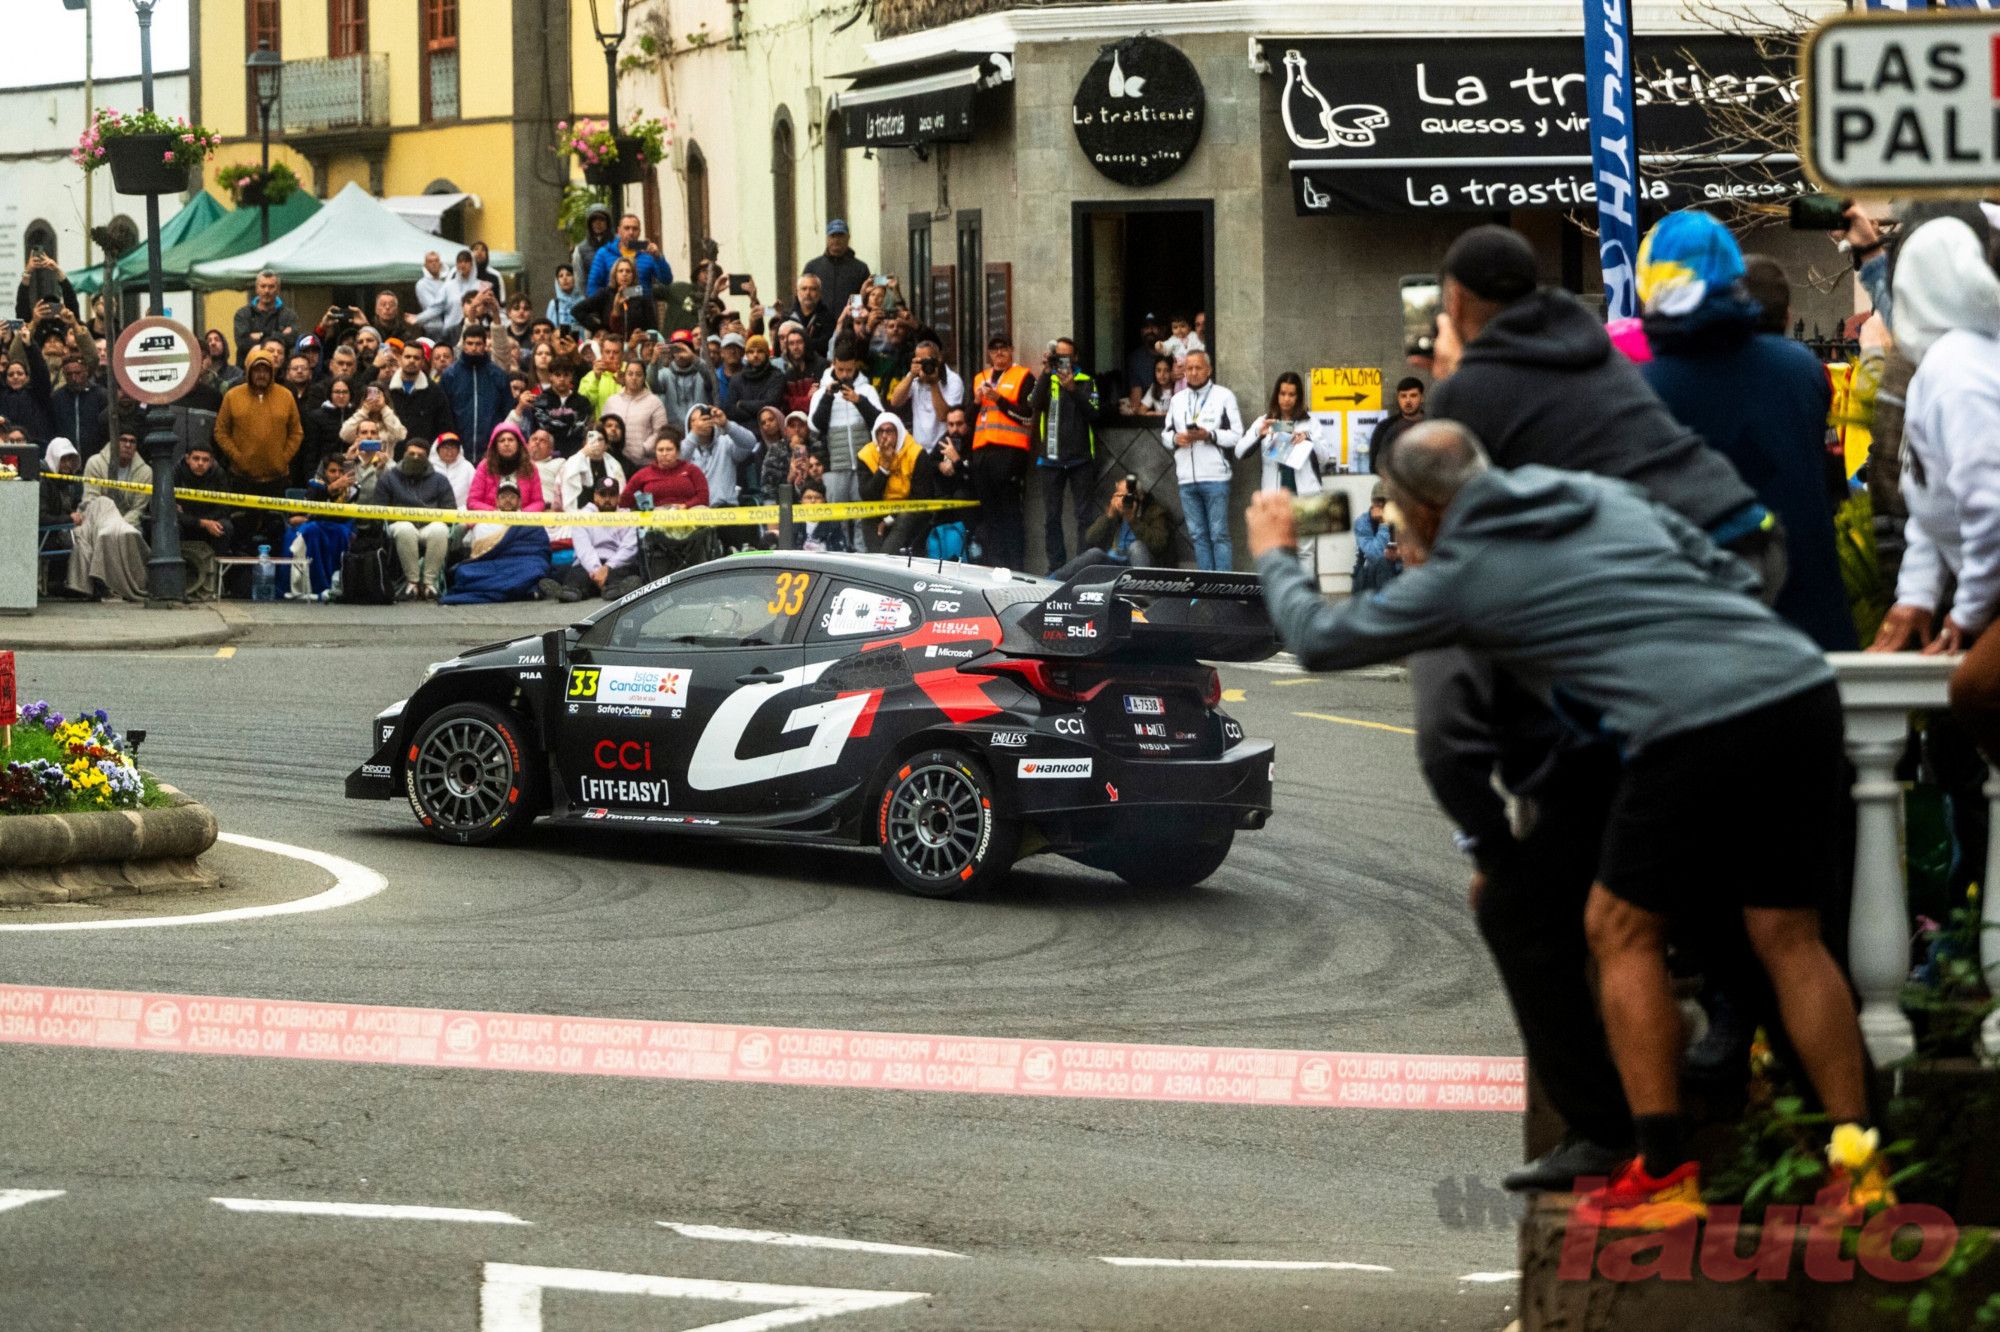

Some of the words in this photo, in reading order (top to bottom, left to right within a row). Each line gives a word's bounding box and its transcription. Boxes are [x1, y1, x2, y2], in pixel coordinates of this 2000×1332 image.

[1832, 41, 1967, 93] LAS
[1416, 63, 1488, 106] La
[1510, 64, 1804, 107] trstien
[1073, 105, 1093, 124] La
[1100, 105, 1195, 123] trastienda
[1535, 117, 1548, 137] y
[1556, 111, 1592, 132] vin
[1832, 106, 2000, 163] PAL
[1406, 177, 1450, 207] La
[1461, 175, 1670, 207] trastiea
[1333, 369, 1382, 386] PALOMO
[357, 504, 391, 515] ZONA
[393, 506, 443, 517] PUBLICO
[490, 512, 541, 522] PUBLICO
[652, 511, 690, 522] ZONA
[693, 511, 737, 522] PUBLICO
[748, 510, 779, 520] ZONA
[791, 507, 833, 519] UBLICO
[589, 512, 639, 523] PUBLICO
[1116, 574, 1195, 593] Panasonic
[767, 572, 810, 616] 33
[933, 622, 979, 631] NISULA
[1067, 621, 1097, 638] Stilo
[938, 647, 974, 658] Microsoft
[518, 655, 545, 664] TAMA
[520, 671, 543, 680] PIAA
[634, 671, 659, 682] Islas
[569, 670, 600, 696] 33
[609, 680, 657, 693] Canarias
[597, 705, 652, 717] SafetyCulture
[1134, 723, 1156, 736] Mobil
[990, 732, 1028, 745] ENDLESS
